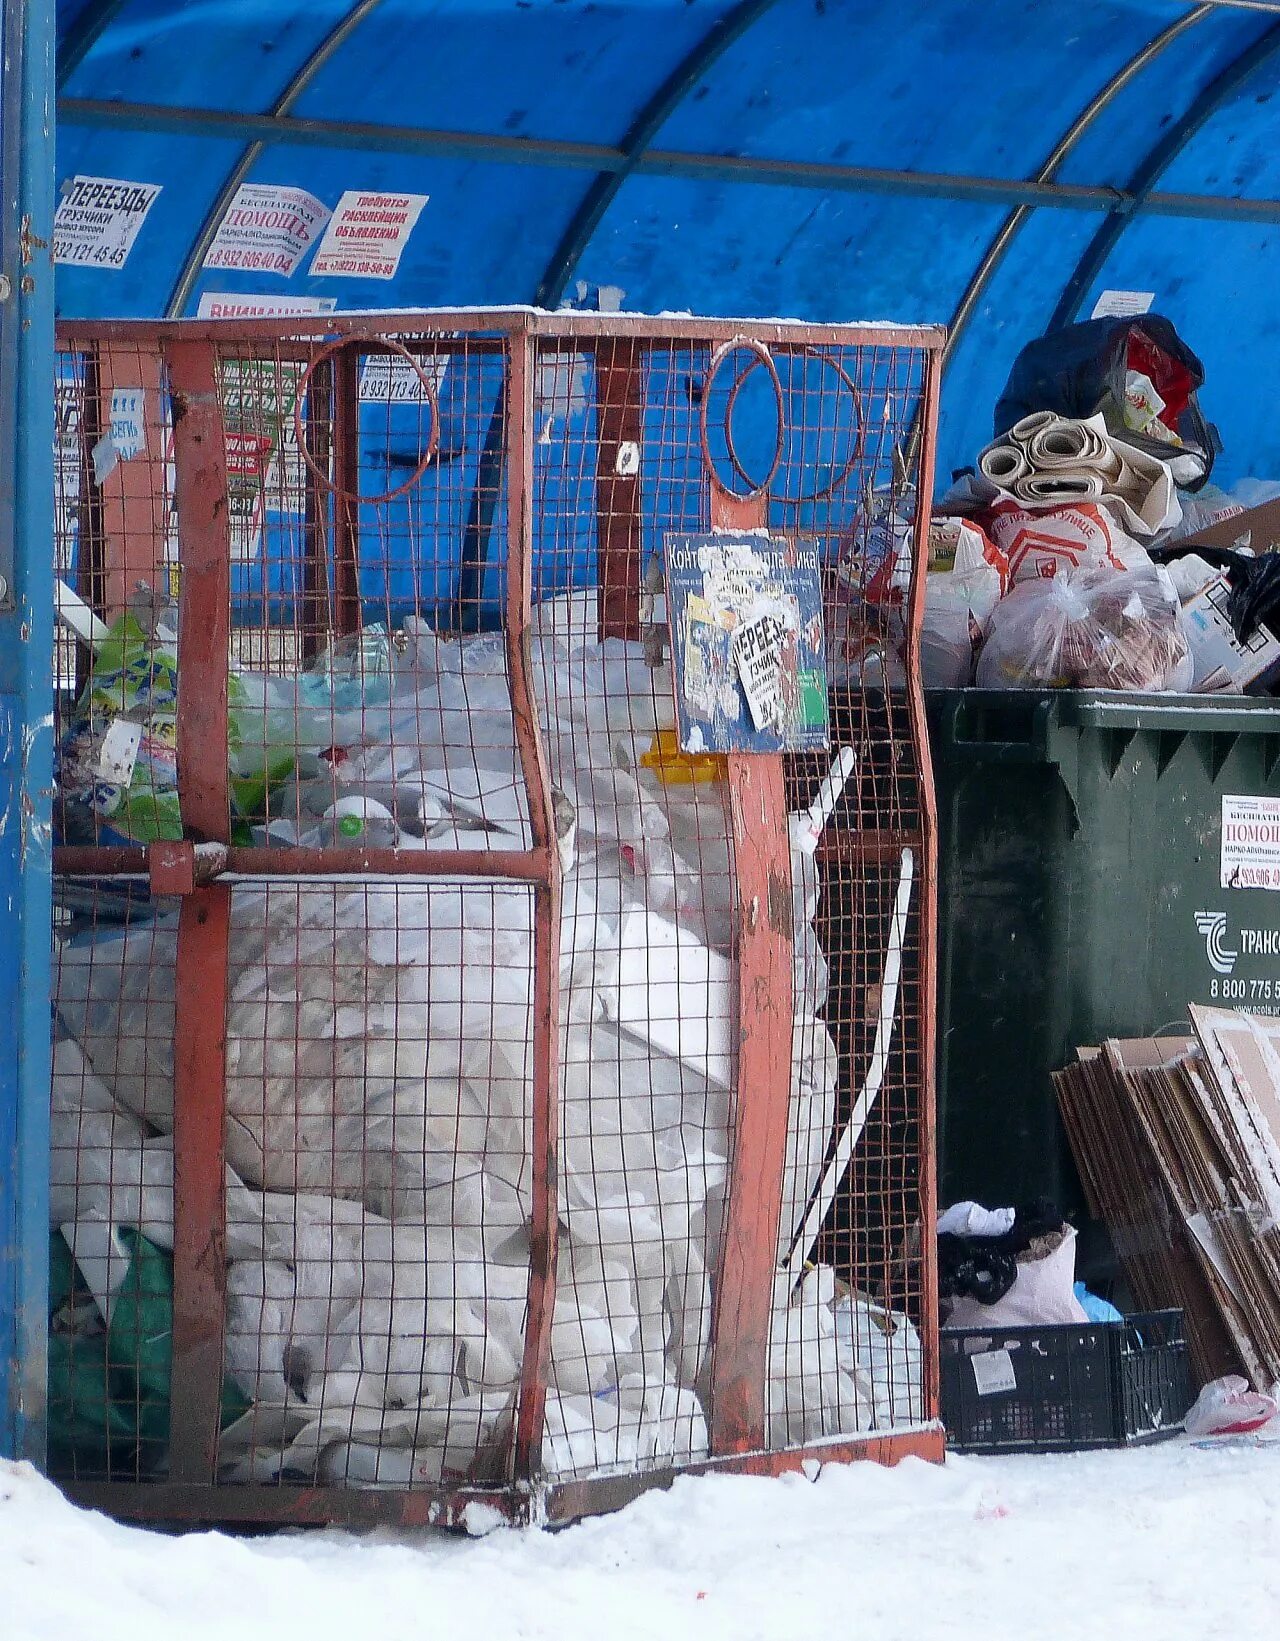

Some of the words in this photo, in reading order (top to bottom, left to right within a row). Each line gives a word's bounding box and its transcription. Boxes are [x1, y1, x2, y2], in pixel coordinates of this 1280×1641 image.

[65, 182, 157, 216] ПЕРЕЕЗДЫ
[58, 208, 114, 224] ГРУЗЧИКИ
[226, 209, 309, 241] ПОМОЩЬ
[73, 243, 94, 260] 121
[1210, 978, 1218, 998] 8
[1222, 979, 1246, 998] 800
[1250, 980, 1272, 999] 775
